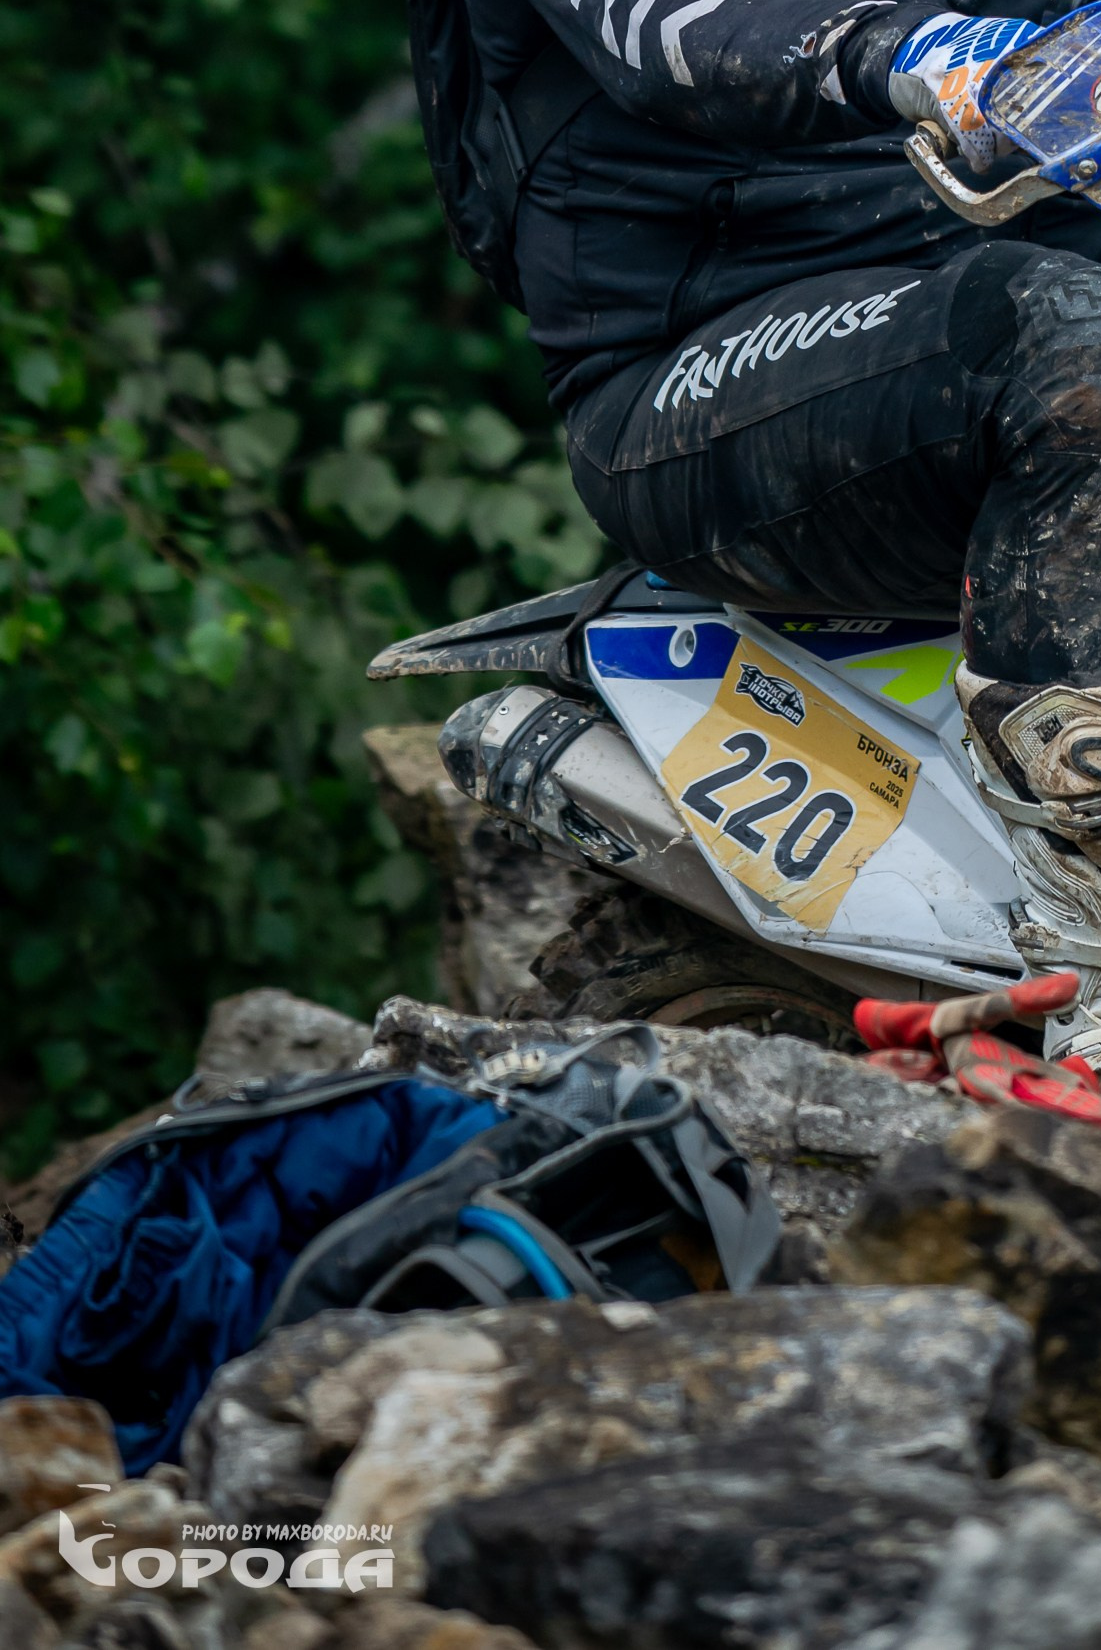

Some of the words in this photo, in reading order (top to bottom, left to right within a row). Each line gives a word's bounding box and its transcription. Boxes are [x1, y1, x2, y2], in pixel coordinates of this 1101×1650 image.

[754, 675, 787, 702] ТОЧКА
[857, 732, 909, 783] БРОНЗА
[868, 781, 900, 810] САМАРА
[886, 780, 904, 799] 2025
[682, 731, 855, 881] 220
